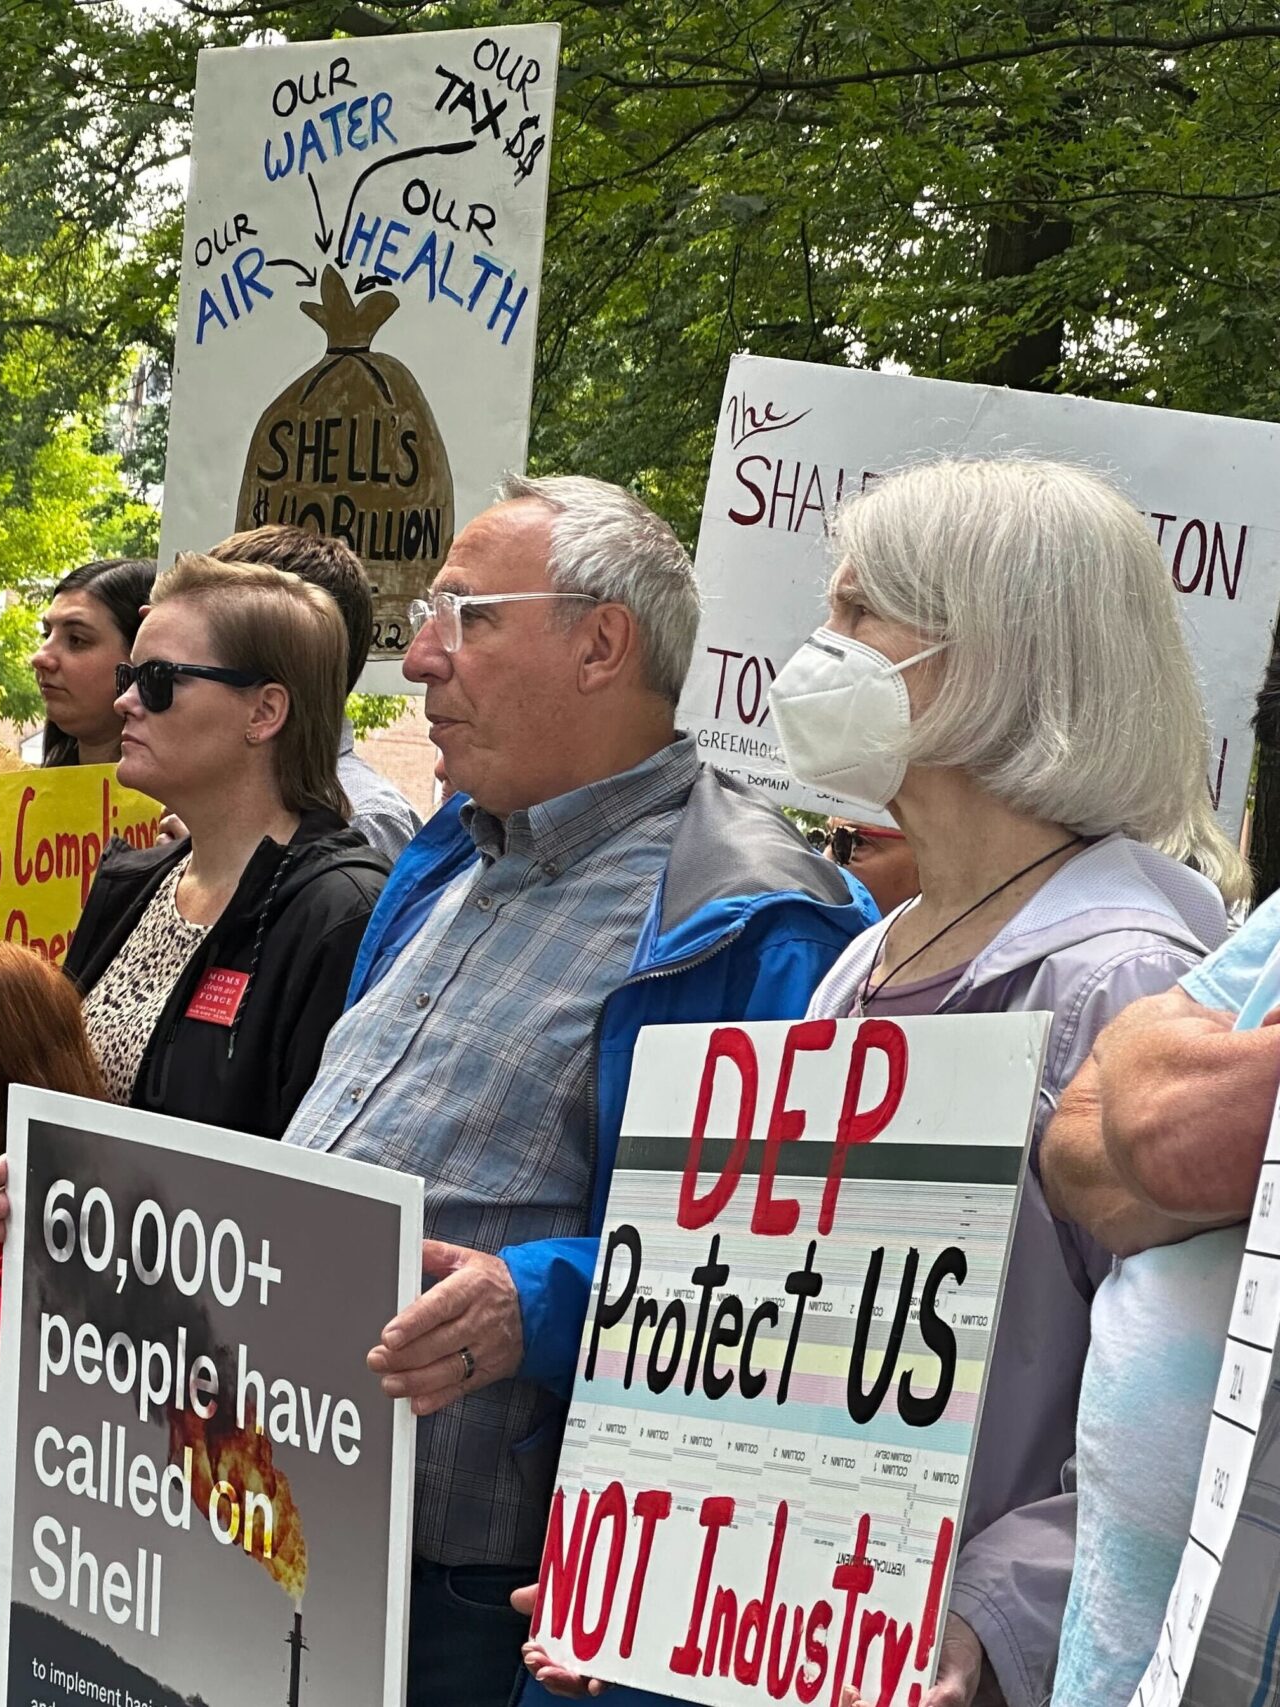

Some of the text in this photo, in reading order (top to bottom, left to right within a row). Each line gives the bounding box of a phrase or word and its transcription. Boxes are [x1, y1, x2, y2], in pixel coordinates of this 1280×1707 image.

[272, 57, 358, 118] OUR
[435, 64, 508, 139] TAX
[473, 38, 541, 111] OUR
[263, 92, 398, 182] WATER
[194, 213, 258, 270] OUR
[402, 178, 496, 247] OUR
[195, 246, 274, 345] AIR
[345, 211, 529, 346] HEALTH
[727, 391, 798, 443] The
[257, 413, 419, 488] SHELL'S
[728, 455, 888, 537] SHA
[331, 494, 441, 562] BILLION
[698, 729, 786, 764] GREENHOU
[747, 773, 790, 791] DOMAIN
[14, 777, 166, 909] Complianc
[199, 992, 233, 1006] FORCE
[208, 972, 241, 986] MOMS
[676, 1018, 910, 1237] DEP
[43, 1179, 282, 1308] 60,000+
[584, 1224, 968, 1426] Protect US
[808, 1300, 833, 1313] COLUMN
[960, 1312, 988, 1327] COLUMN
[37, 1312, 362, 1466] people have
[606, 1423, 627, 1436] COLUMN
[646, 1428, 669, 1442] COLUMN
[689, 1434, 713, 1448] COLUMN
[734, 1441, 759, 1455] COLUMN
[780, 1449, 806, 1462] COLUMN
[891, 1451, 912, 1464] COLUMN
[33, 1421, 275, 1560] called on
[830, 1455, 856, 1469] COLUMN
[881, 1463, 908, 1477] COLUMN
[932, 1470, 960, 1486] COLUMN
[29, 1515, 162, 1637] Shell
[529, 1480, 957, 1707] NOT Industry!
[32, 1657, 47, 1681] to
[50, 1662, 122, 1707] implement
